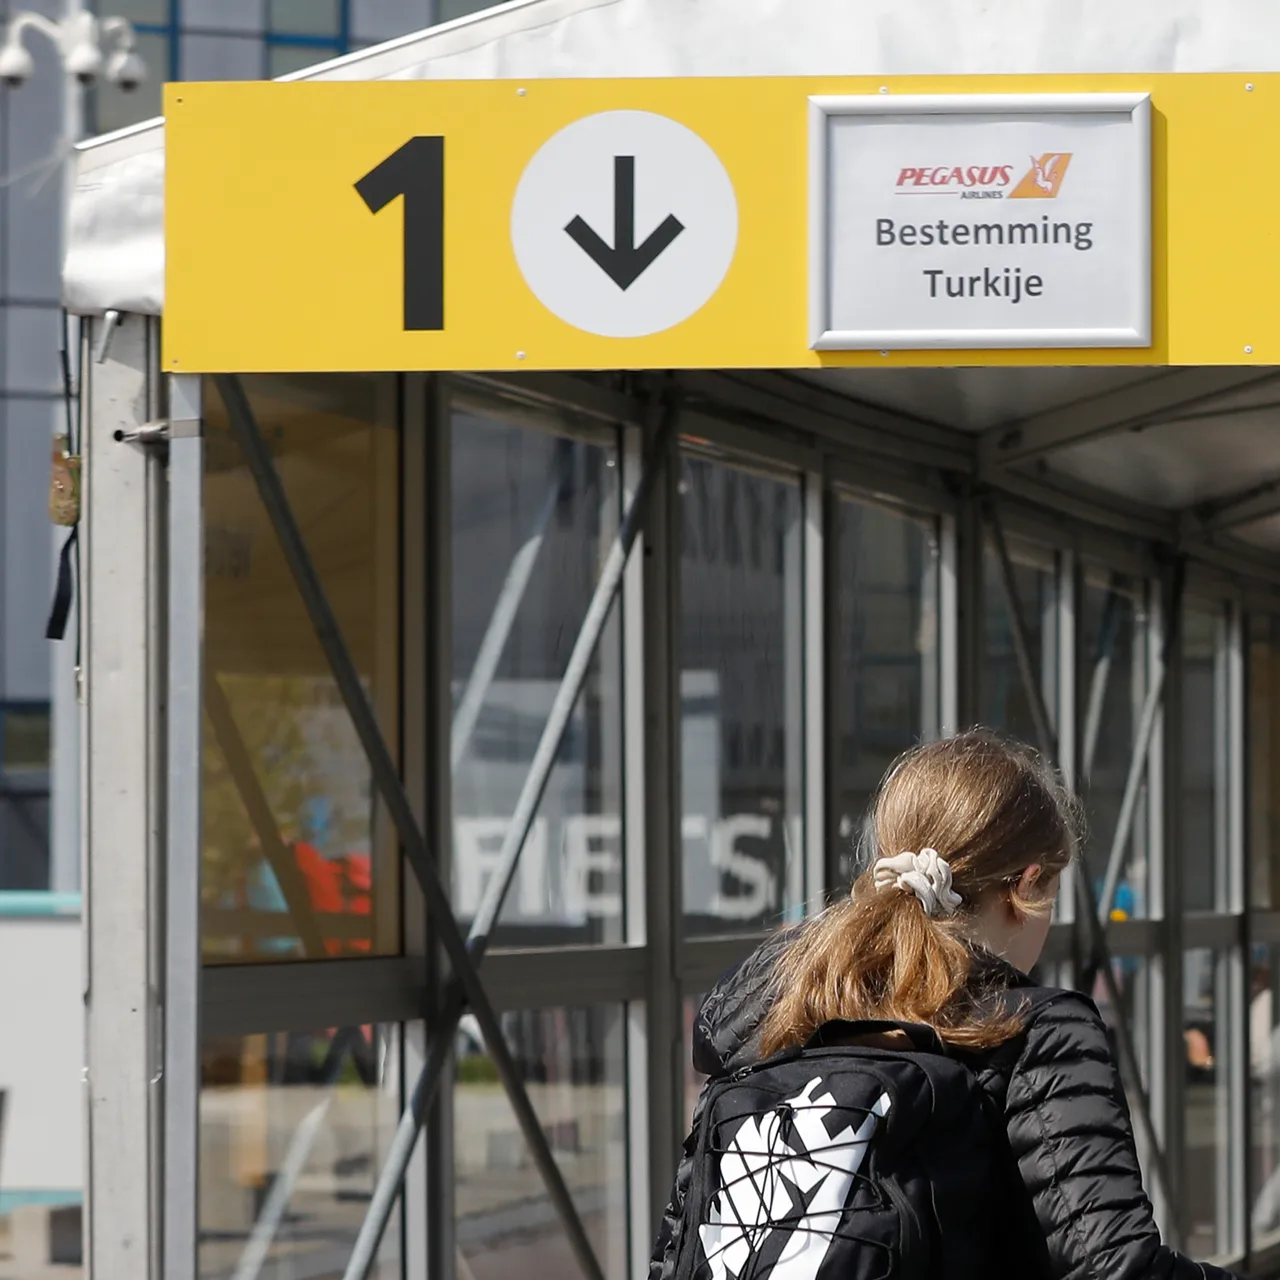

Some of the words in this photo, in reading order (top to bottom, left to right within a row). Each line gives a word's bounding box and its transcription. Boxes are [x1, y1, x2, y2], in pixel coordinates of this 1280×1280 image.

[895, 164, 1014, 188] PEGASUS
[960, 190, 1004, 200] AIRLINES
[353, 135, 445, 331] 1
[875, 214, 1094, 251] Bestemming
[922, 266, 1044, 304] Turkije
